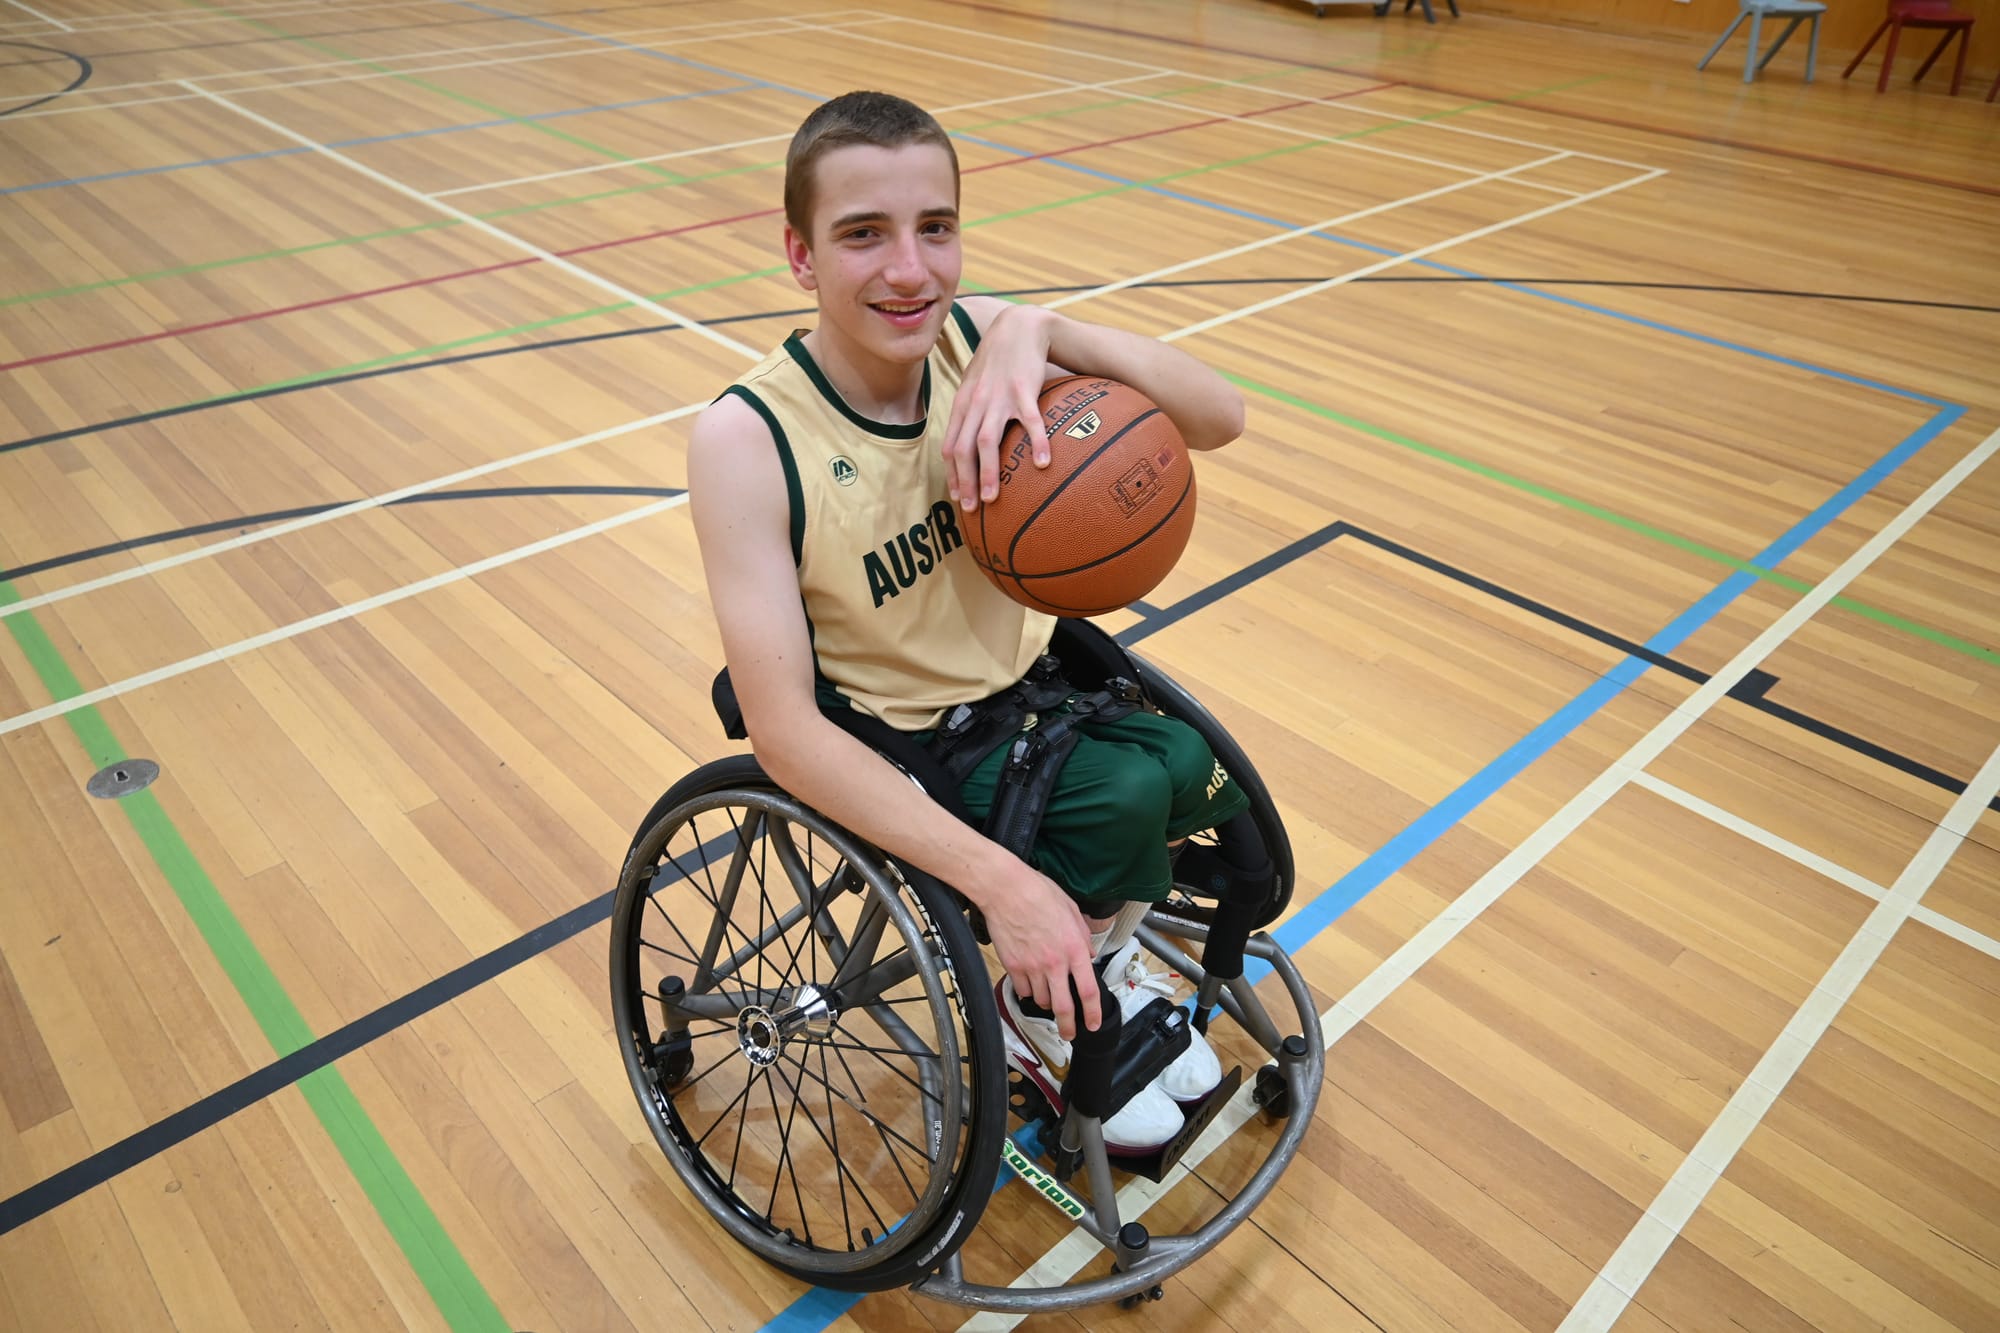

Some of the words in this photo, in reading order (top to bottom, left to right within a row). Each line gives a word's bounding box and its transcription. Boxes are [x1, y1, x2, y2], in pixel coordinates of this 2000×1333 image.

[999, 430, 1035, 486] SUPE
[1046, 388, 1092, 420] FLITE
[1067, 412, 1097, 435] TF
[1206, 757, 1229, 801] AUS
[1008, 1153, 1083, 1217] orion
